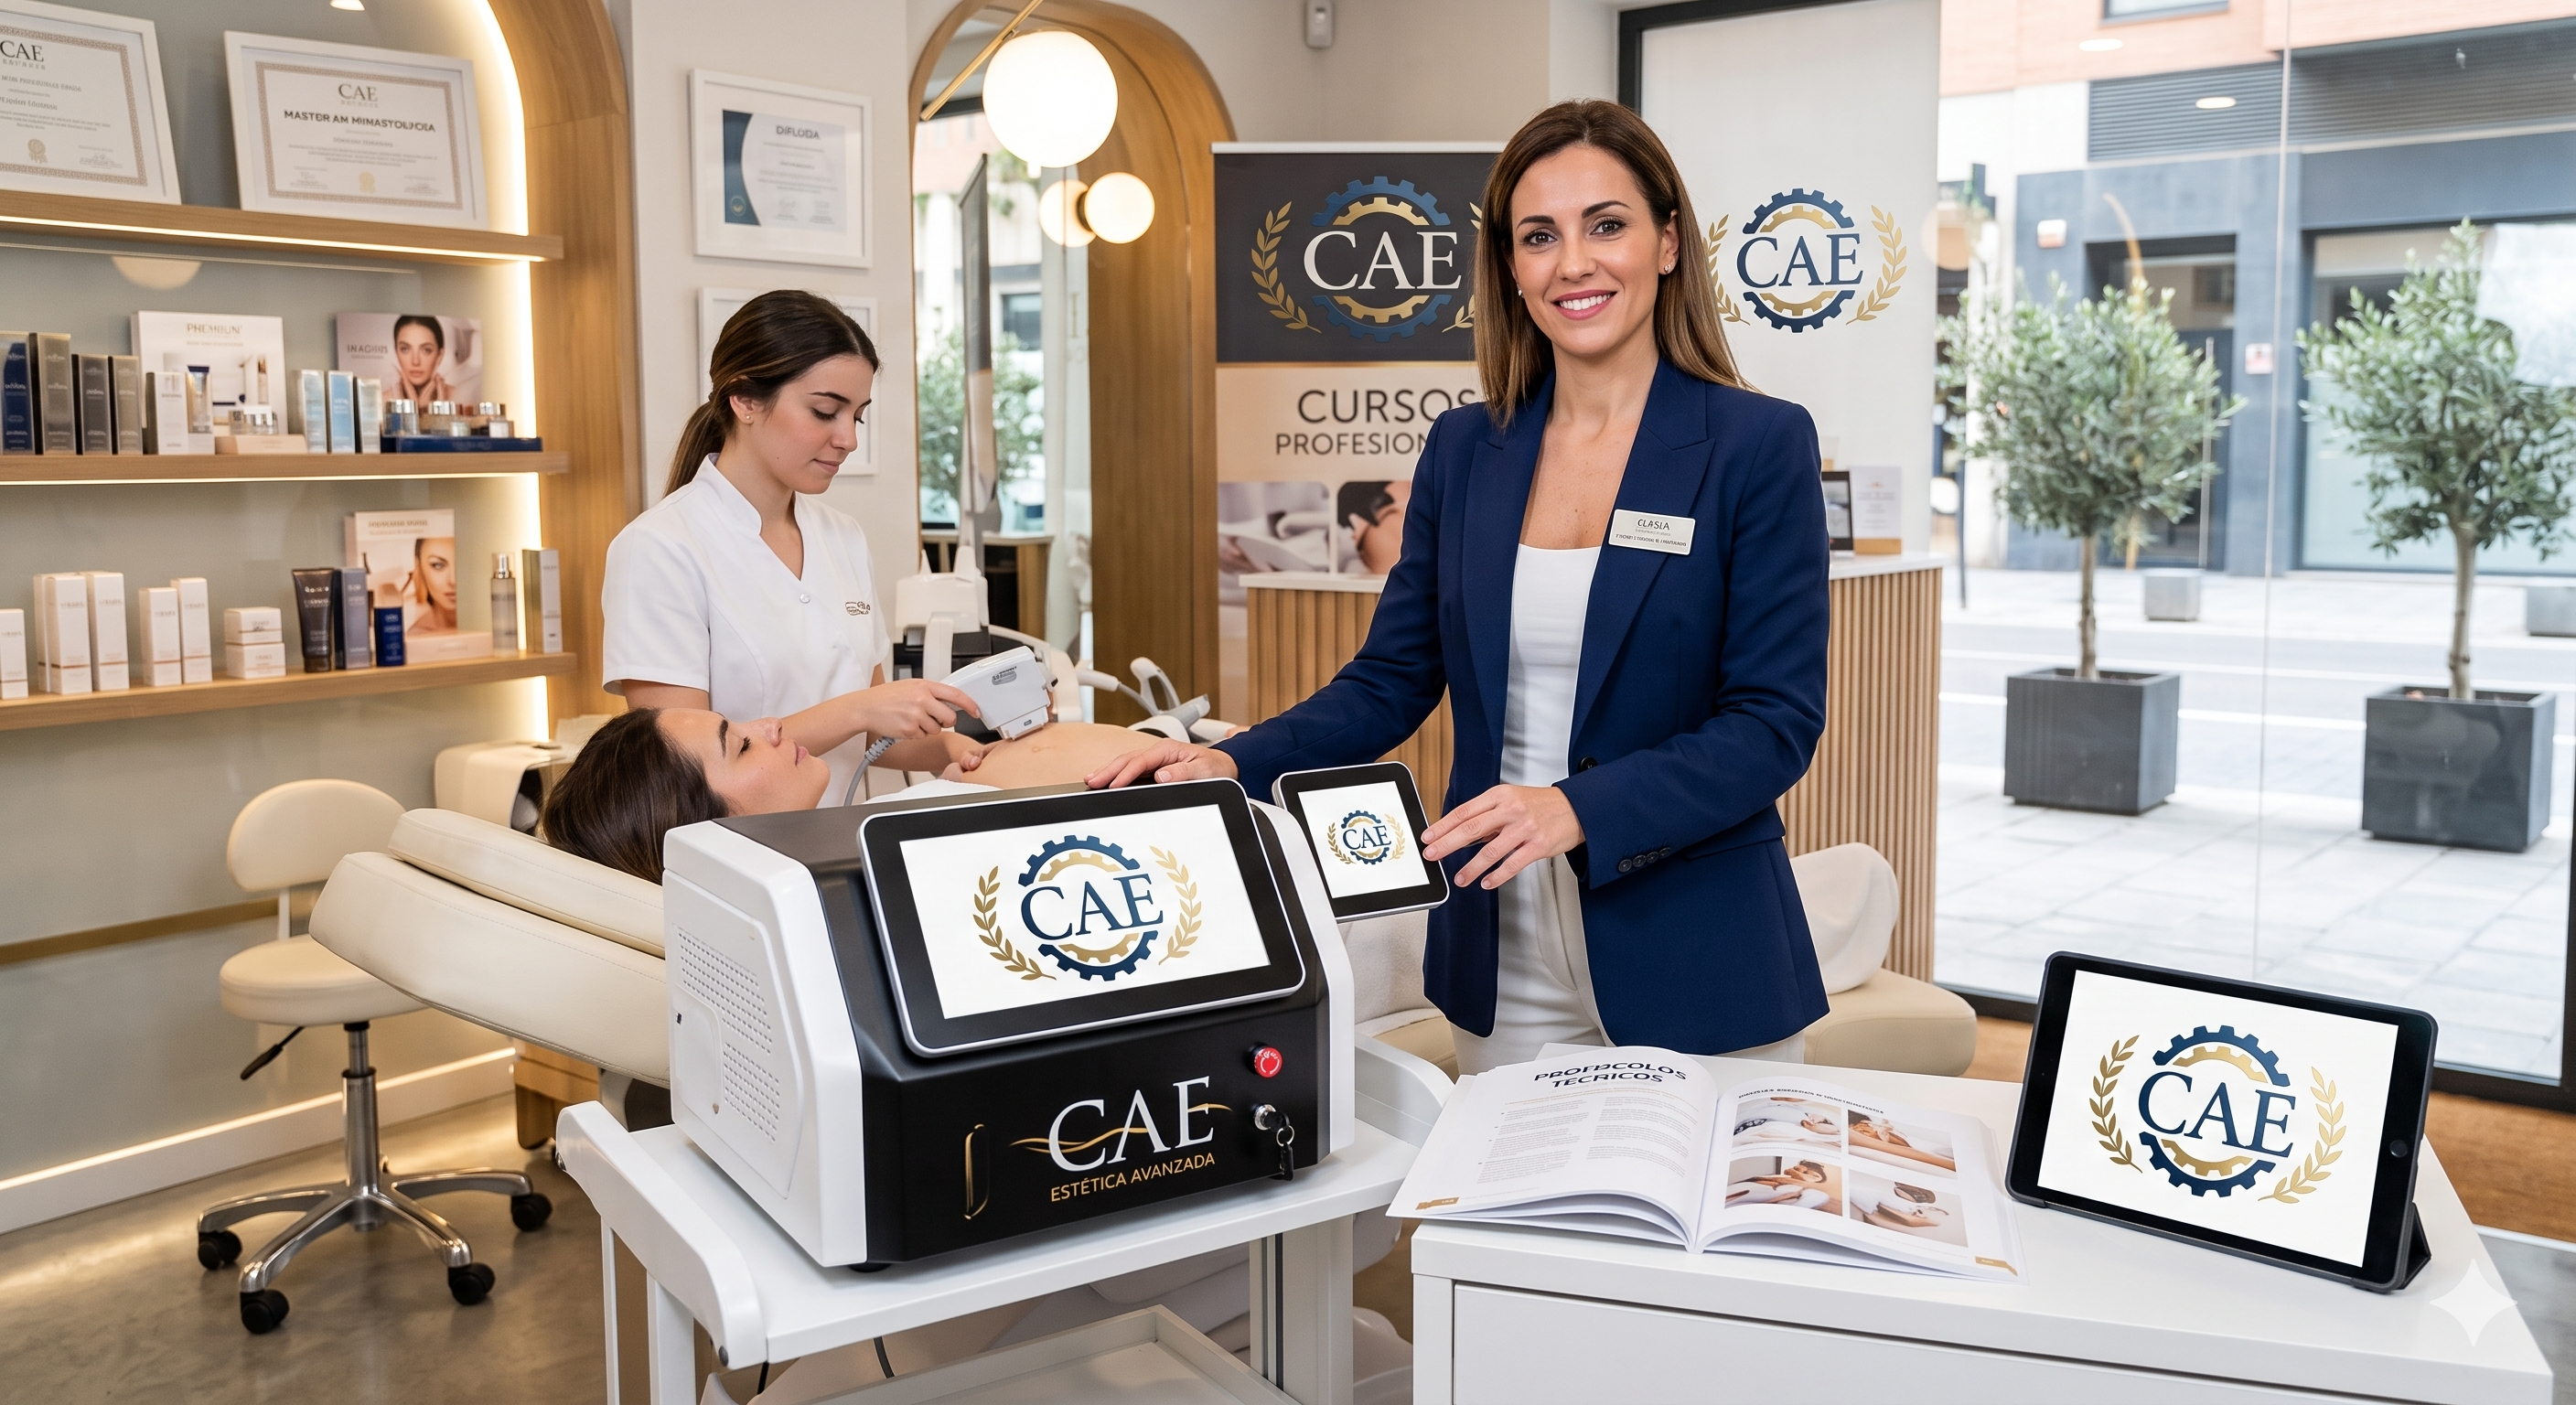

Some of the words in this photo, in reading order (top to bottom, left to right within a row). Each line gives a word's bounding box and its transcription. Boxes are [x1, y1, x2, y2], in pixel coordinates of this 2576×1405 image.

[0, 39, 44, 62] CAE
[338, 83, 378, 102] CAE
[1303, 231, 1462, 291] CAE
[1736, 232, 1864, 289] CAE
[1342, 825, 1392, 851] CAE
[1020, 873, 1164, 940] CAE
[1048, 1076, 1214, 1172] CAE
[2138, 1071, 2296, 1158] CAE
[1051, 1172, 1127, 1202] ESTÉTICA
[1131, 1153, 1216, 1184] AVANZADA
